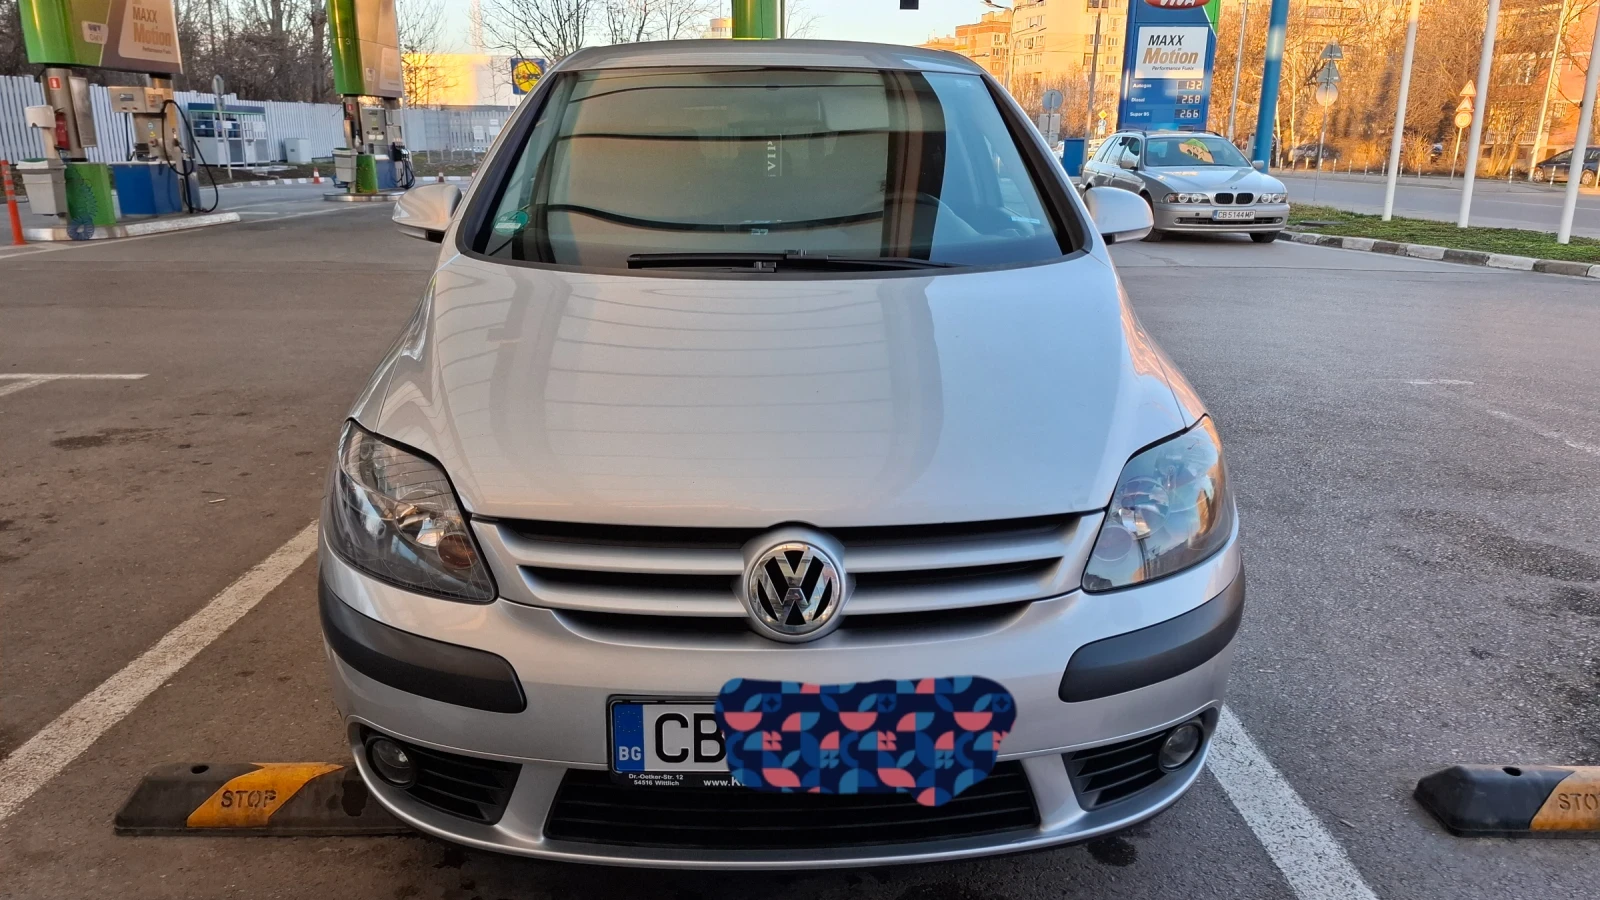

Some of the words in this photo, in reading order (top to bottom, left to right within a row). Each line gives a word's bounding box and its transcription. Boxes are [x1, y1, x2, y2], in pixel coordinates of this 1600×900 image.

[132, 6, 158, 23] MAXX
[133, 22, 172, 46] Motion
[1148, 35, 1185, 46] MAXX
[1142, 47, 1199, 65] Motion
[655, 712, 727, 763] CB
[618, 746, 642, 761] BG
[703, 776, 748, 787] www.K
[220, 789, 277, 809] STOP
[1557, 793, 1600, 811] STO
